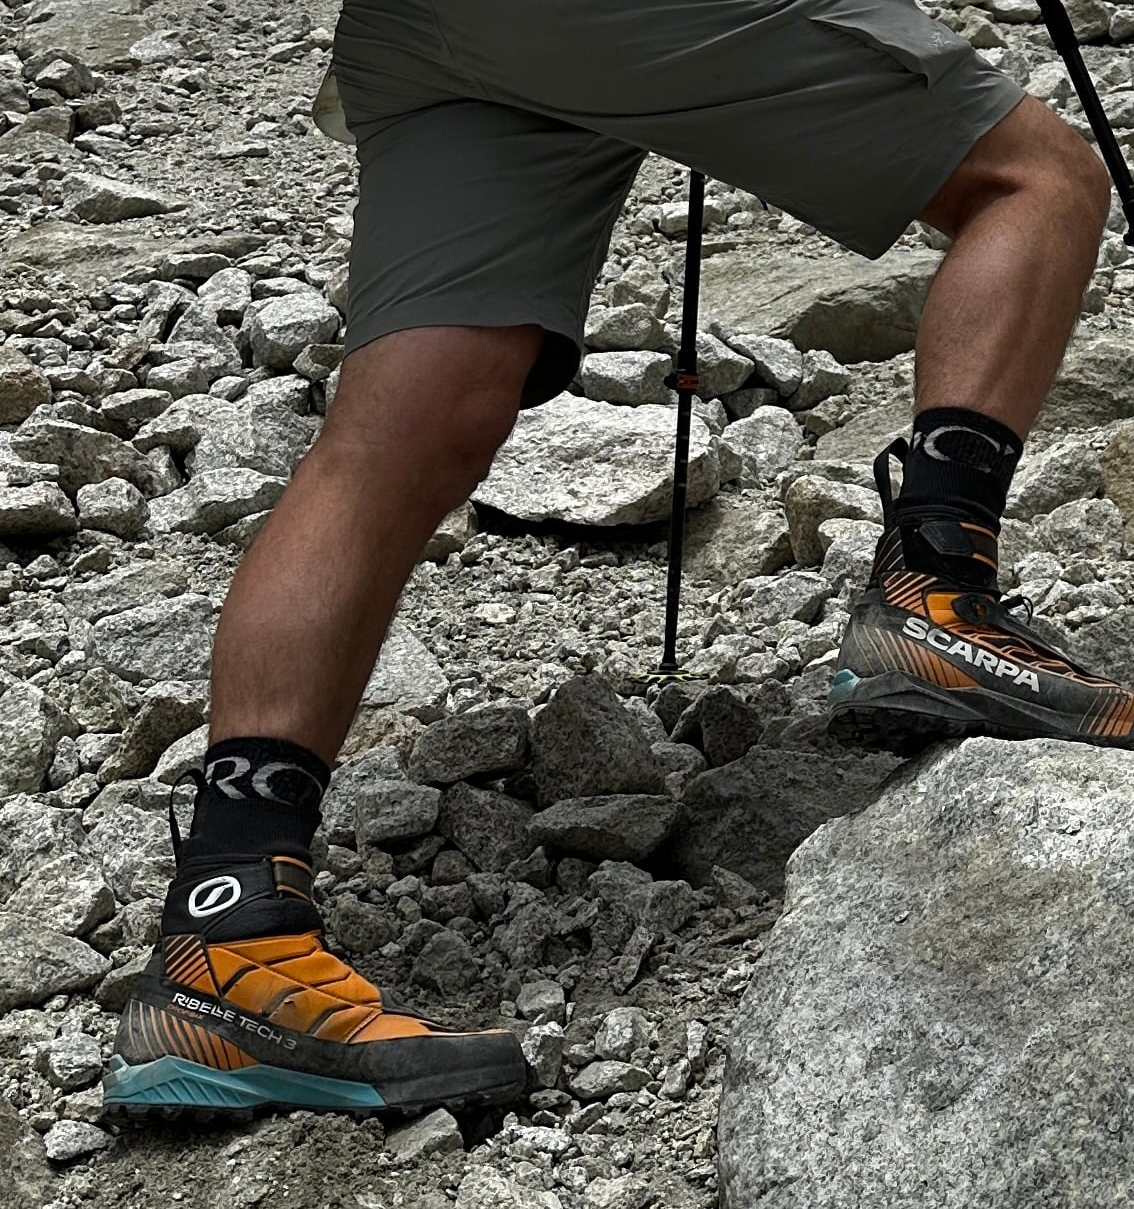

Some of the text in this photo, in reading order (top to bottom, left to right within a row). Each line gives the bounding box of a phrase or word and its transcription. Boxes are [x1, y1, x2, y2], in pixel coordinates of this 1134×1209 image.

[902, 616, 1041, 693] SCARPA
[239, 1015, 283, 1045] TECH
[283, 1038, 297, 1051] 3
